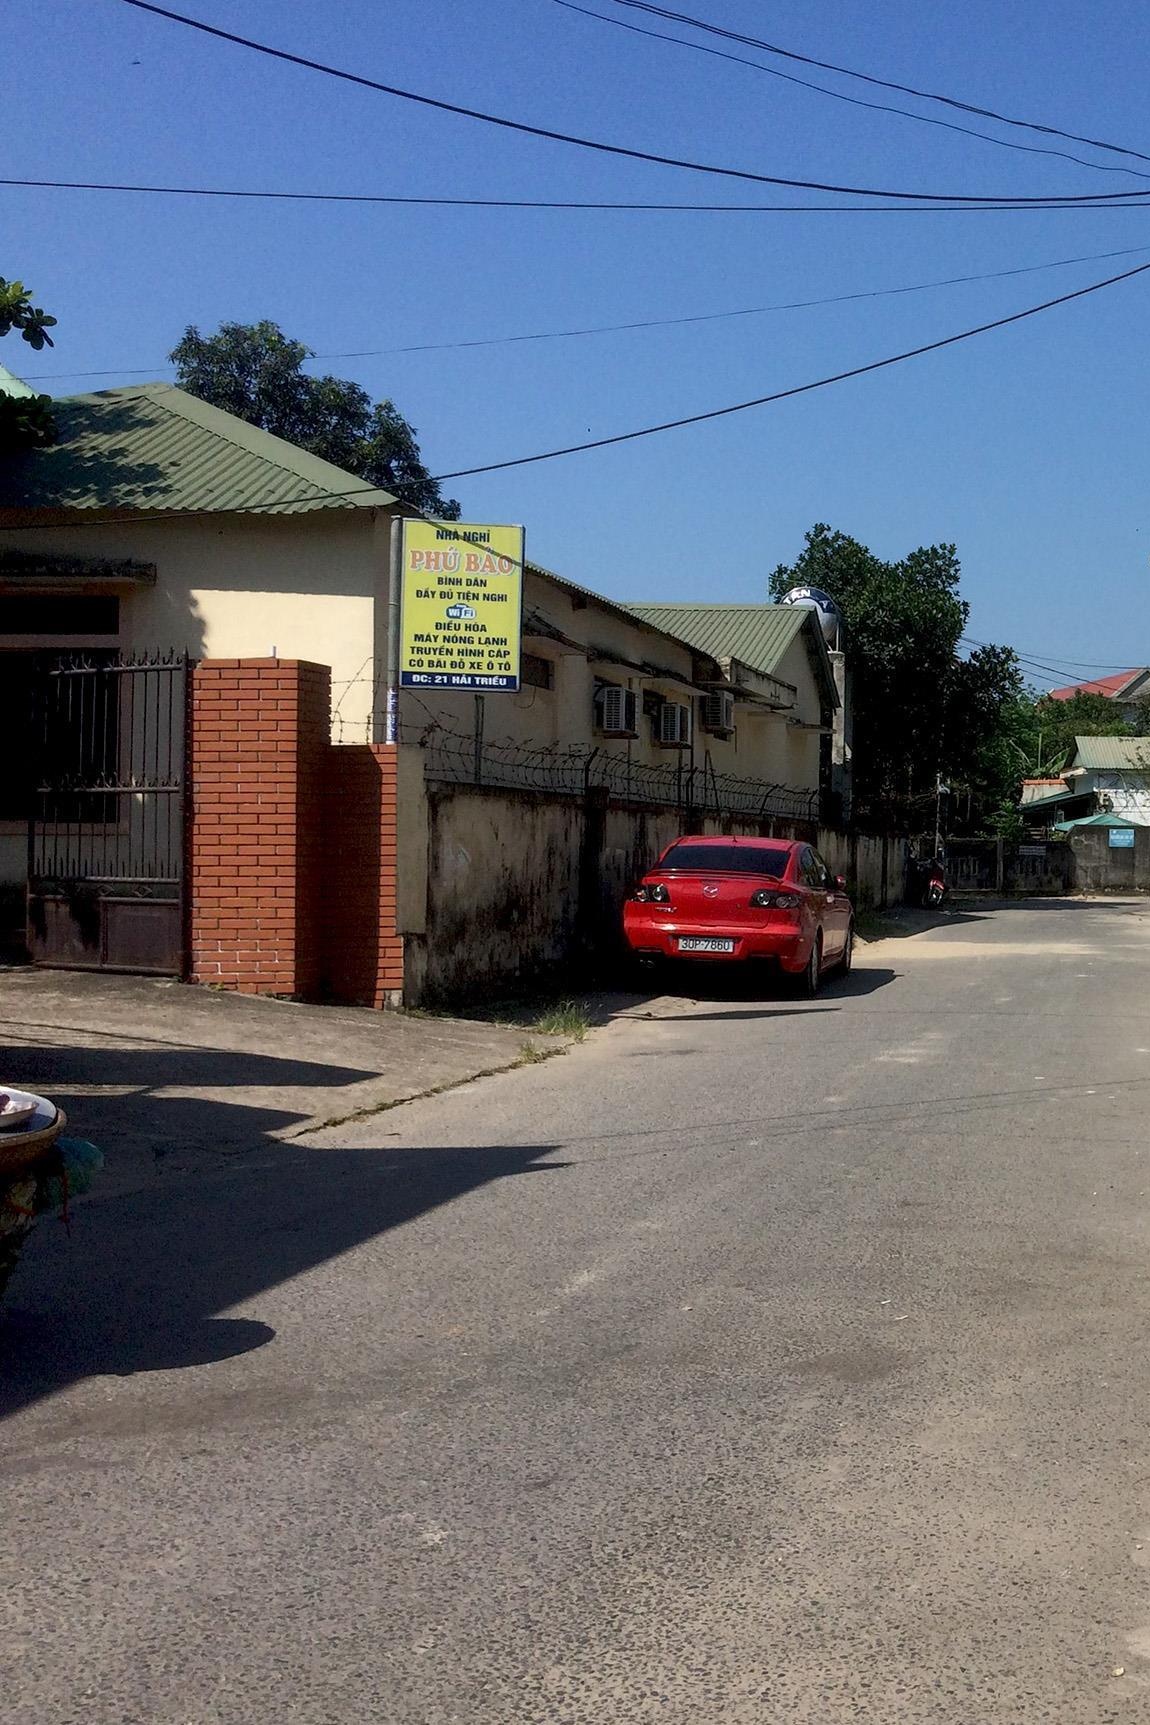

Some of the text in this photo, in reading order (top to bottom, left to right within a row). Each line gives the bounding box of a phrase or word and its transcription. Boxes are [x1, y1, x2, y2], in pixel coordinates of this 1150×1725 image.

[436, 528, 491, 543] NHÀ NGHỈ
[465, 546, 514, 574] BẢO
[437, 576, 487, 588] BÌNH DÂN
[439, 588, 454, 600] ĐỦ
[456, 590, 480, 603] TIỆN
[483, 593, 508, 602] NGHI
[435, 620, 487, 633] ĐIỀU HÒA
[413, 632, 508, 647] MÁY NÓNG LẠNH
[410, 645, 511, 659] TRUYỀN HÌNH CÁP
[409, 657, 424, 668] CÓ
[427, 658, 447, 669] BÃI
[469, 661, 483, 670] XE
[486, 660, 494, 671] Ô
[497, 660, 511, 671] TÔ
[412, 674, 507, 686] ĐC: 21 HẢI TRIỀU
